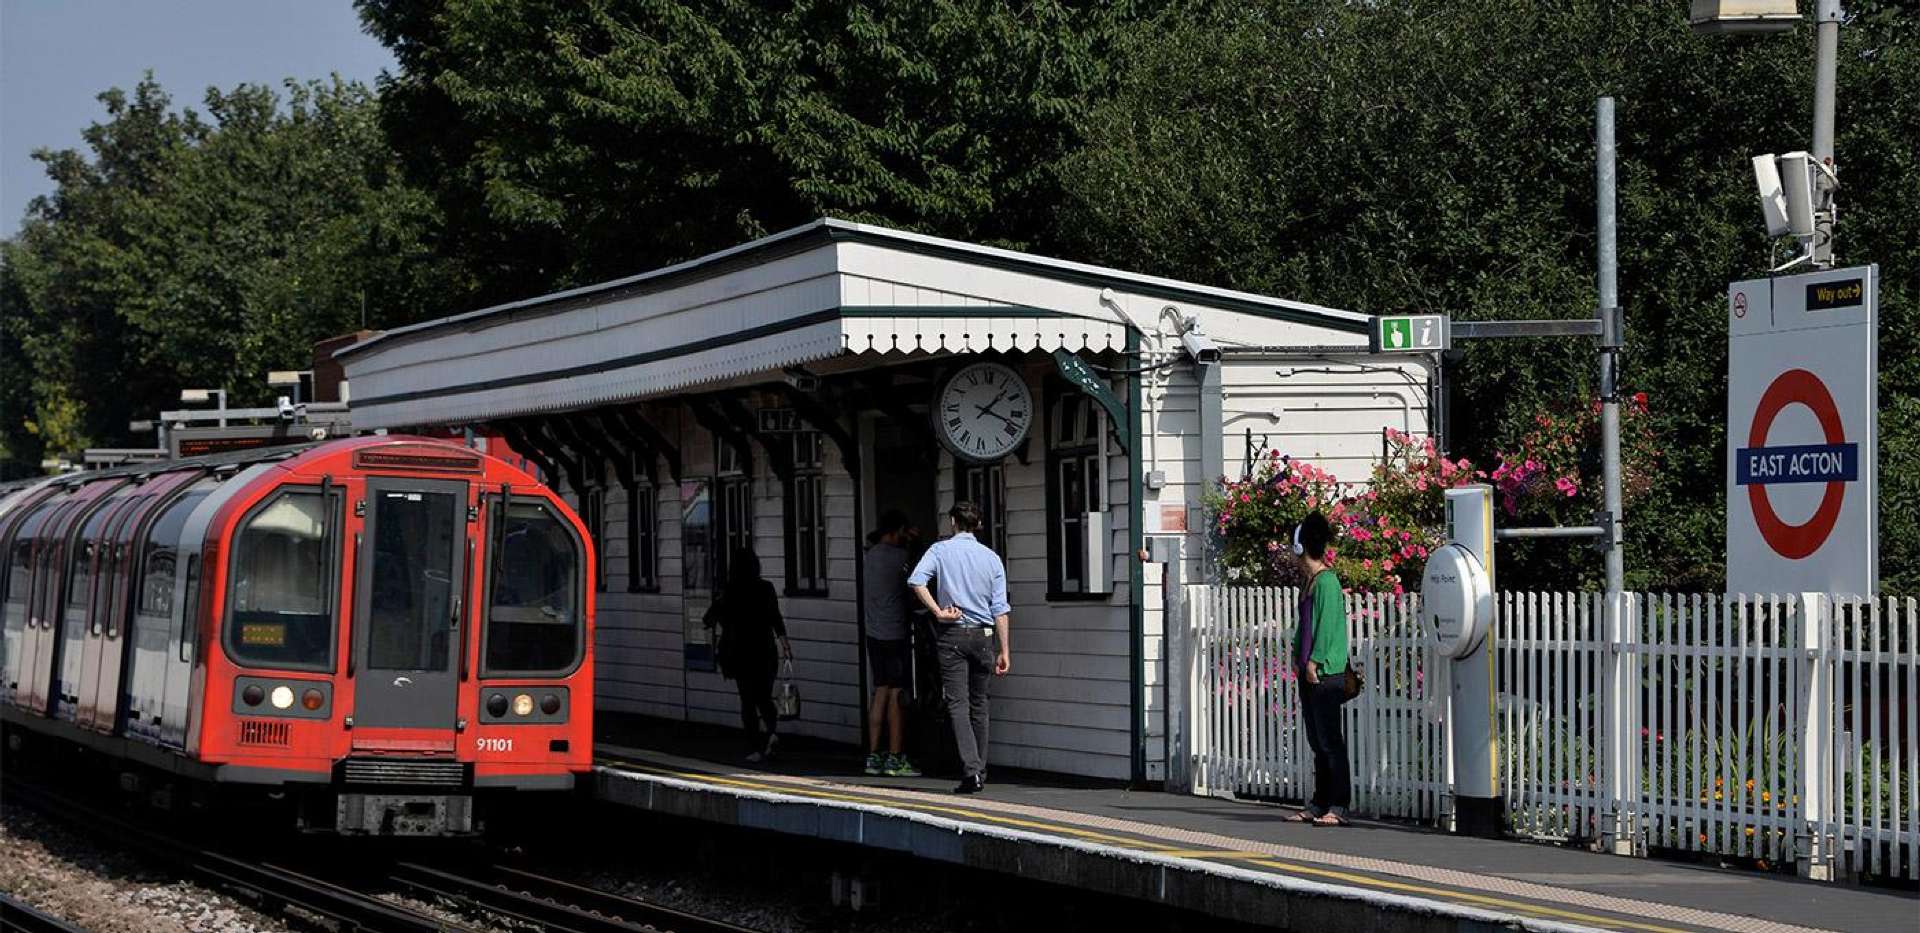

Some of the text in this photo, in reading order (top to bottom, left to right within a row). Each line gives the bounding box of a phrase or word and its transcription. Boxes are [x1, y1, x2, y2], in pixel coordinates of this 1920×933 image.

[1816, 285, 1852, 304] Way out
[1750, 451, 1843, 477] EAST ACTON
[477, 738, 513, 752] 91101
